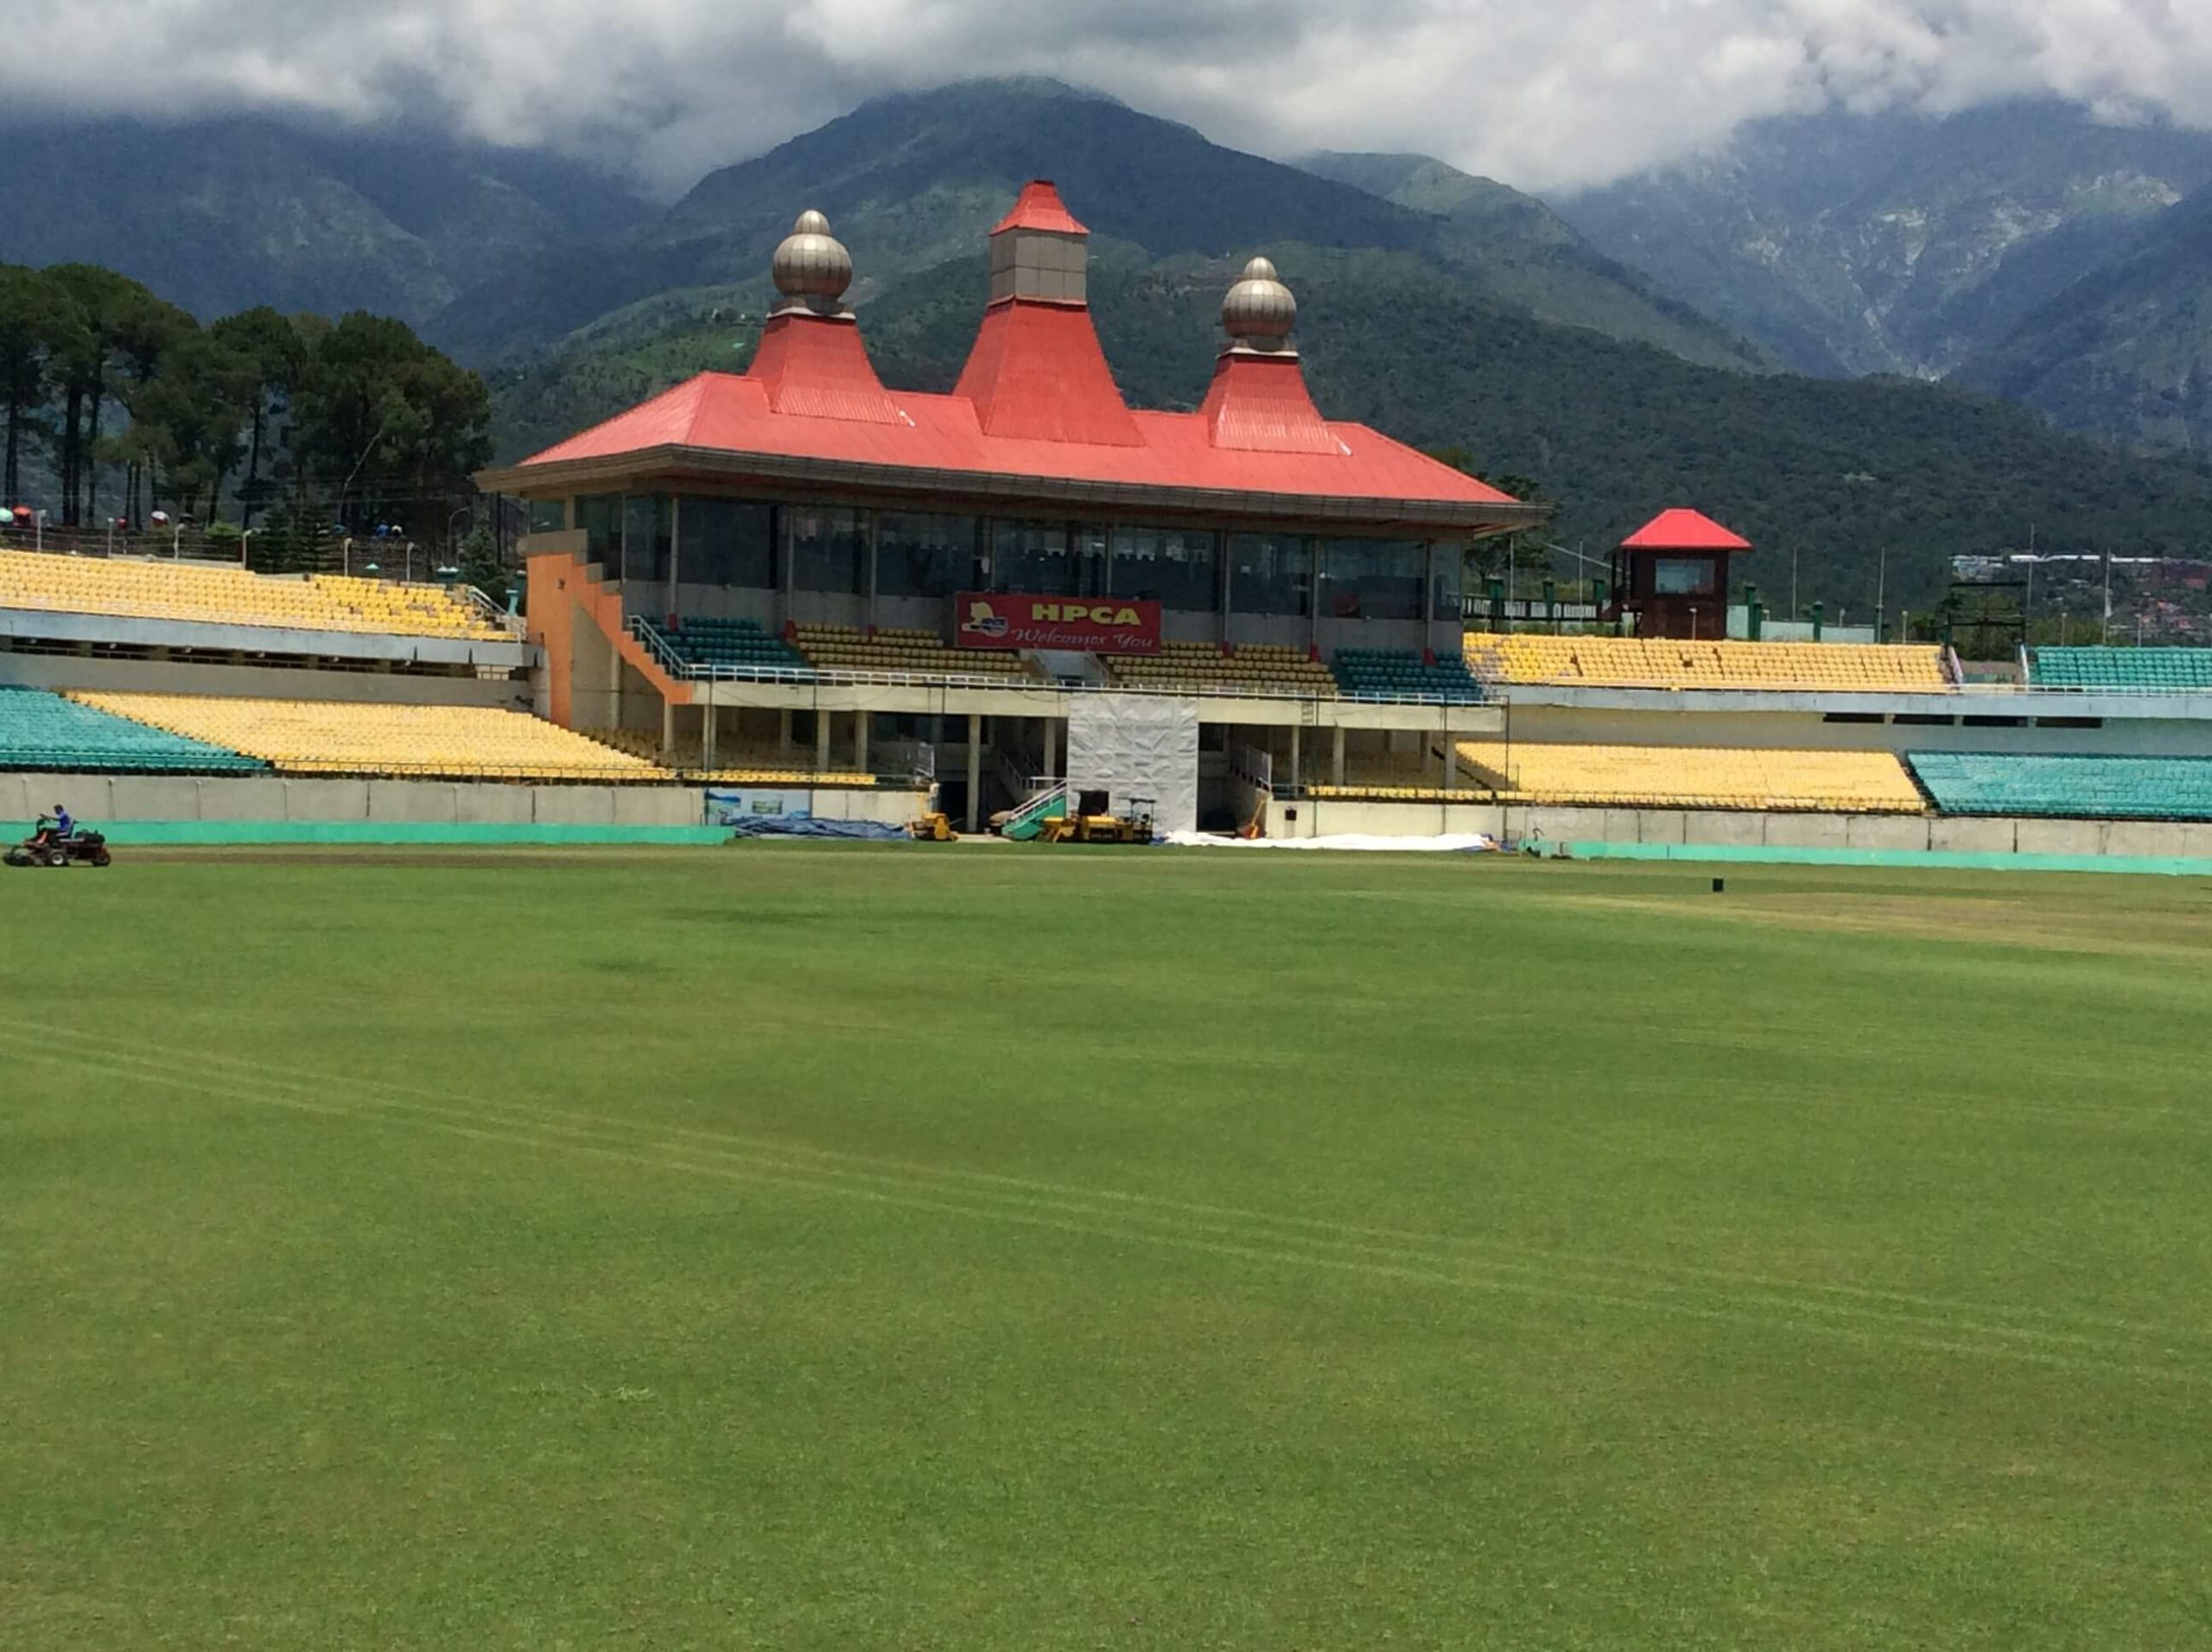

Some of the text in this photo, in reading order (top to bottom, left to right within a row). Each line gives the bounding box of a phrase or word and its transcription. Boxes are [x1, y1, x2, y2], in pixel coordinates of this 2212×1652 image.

[1032, 603, 1142, 626] HPCA
[1011, 627, 1154, 648] Welcomes You
